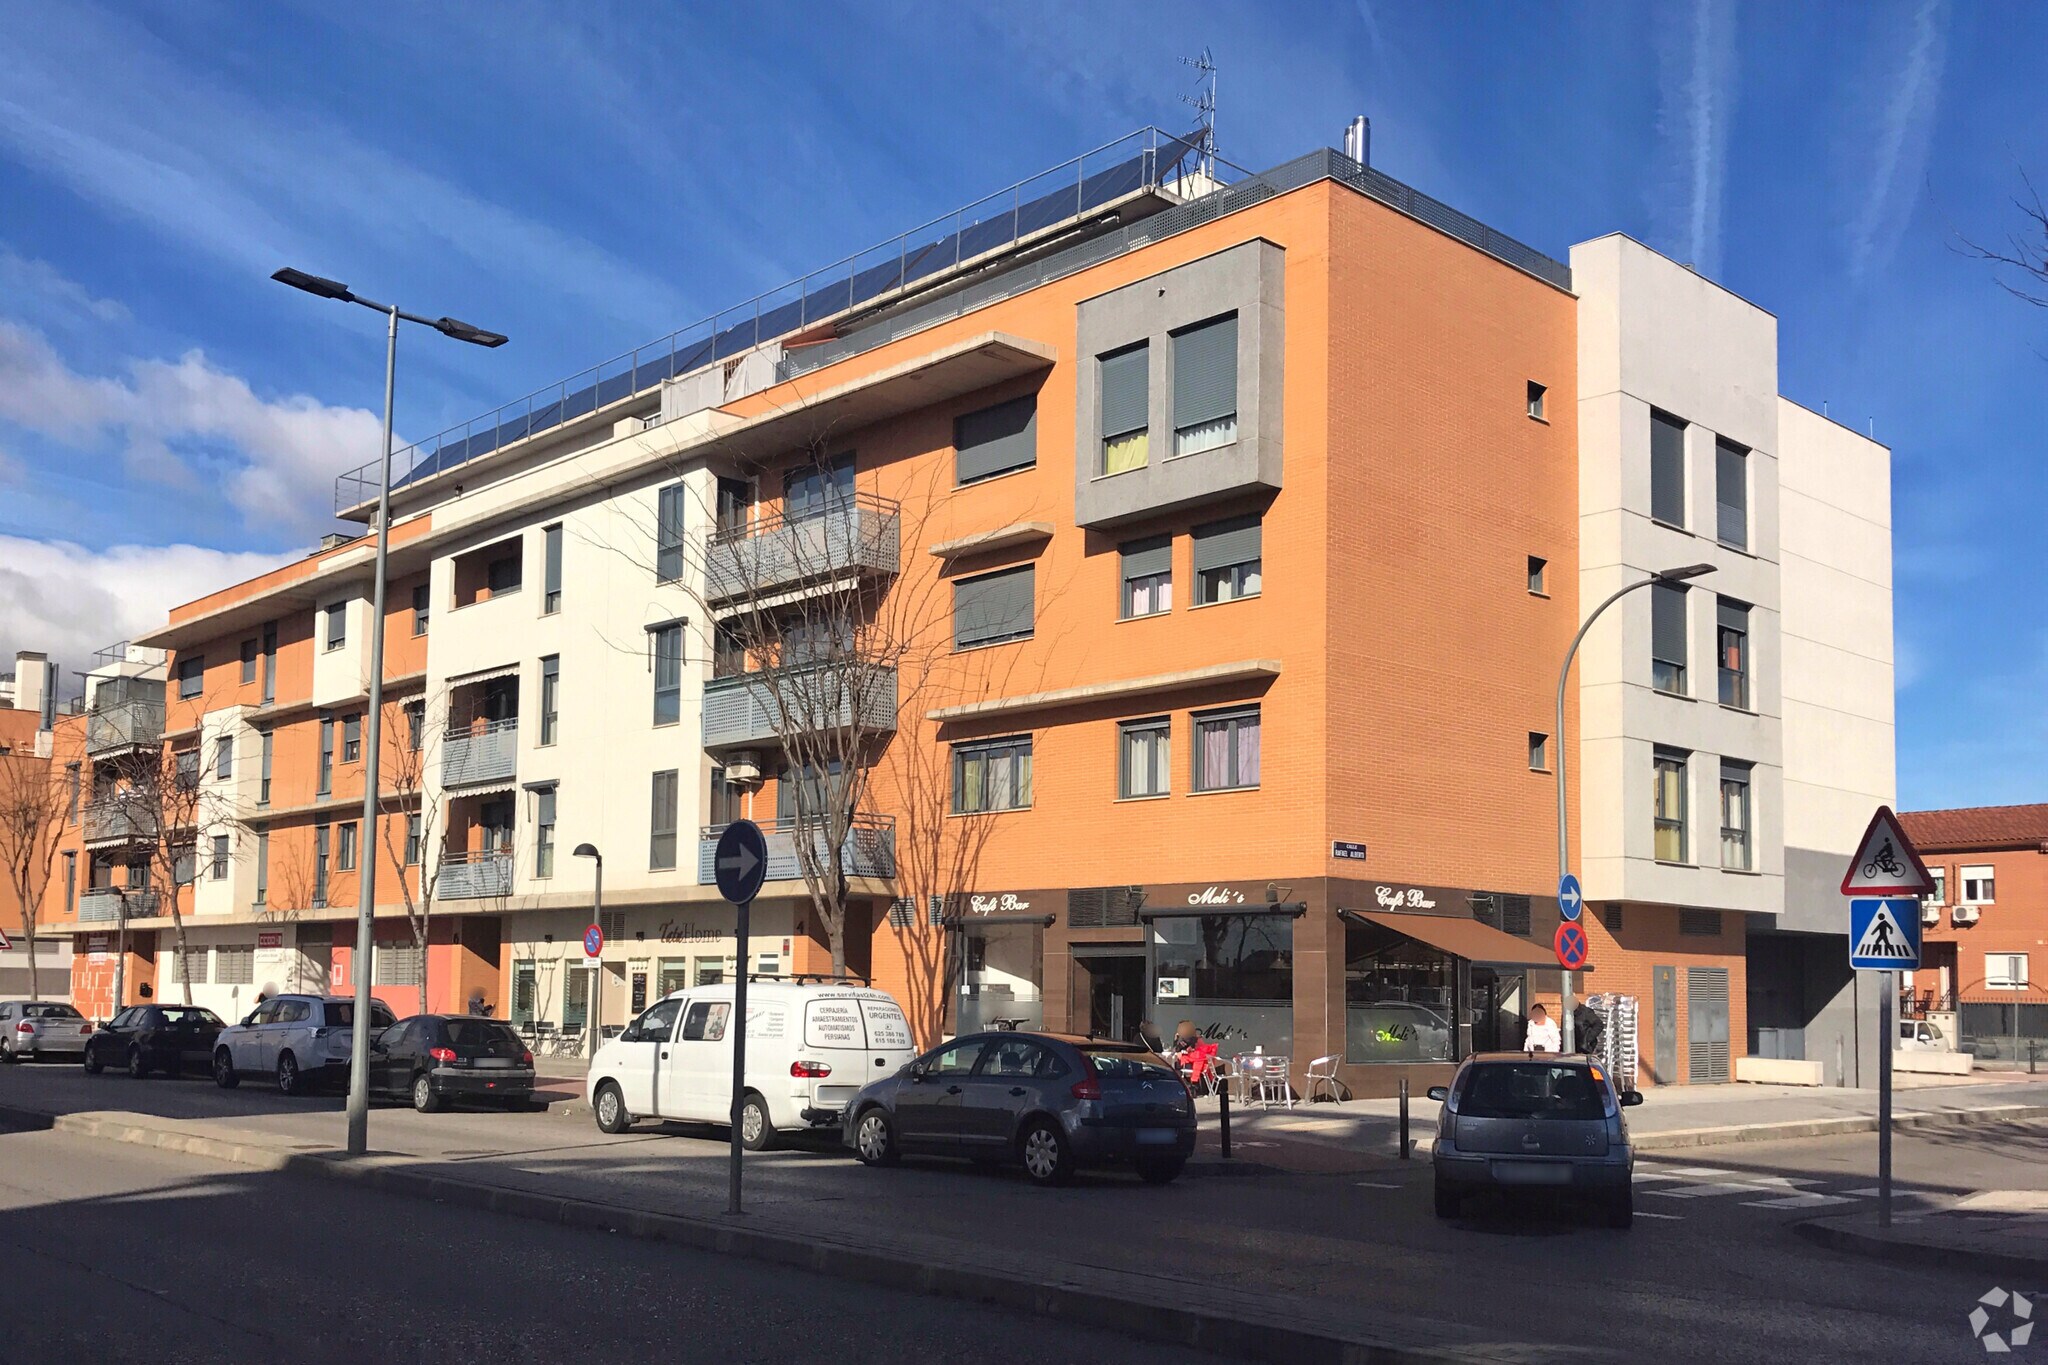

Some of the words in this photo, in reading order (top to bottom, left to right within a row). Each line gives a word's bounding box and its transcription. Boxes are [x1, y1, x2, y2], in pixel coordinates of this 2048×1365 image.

[1335, 849, 1349, 857] RAFAEL
[970, 895, 998, 916] Café
[1000, 894, 1030, 911] Bar
[1375, 886, 1404, 911] Café
[1407, 889, 1436, 908] Bar
[796, 921, 804, 935] 4
[869, 1012, 902, 1020] URGENTES
